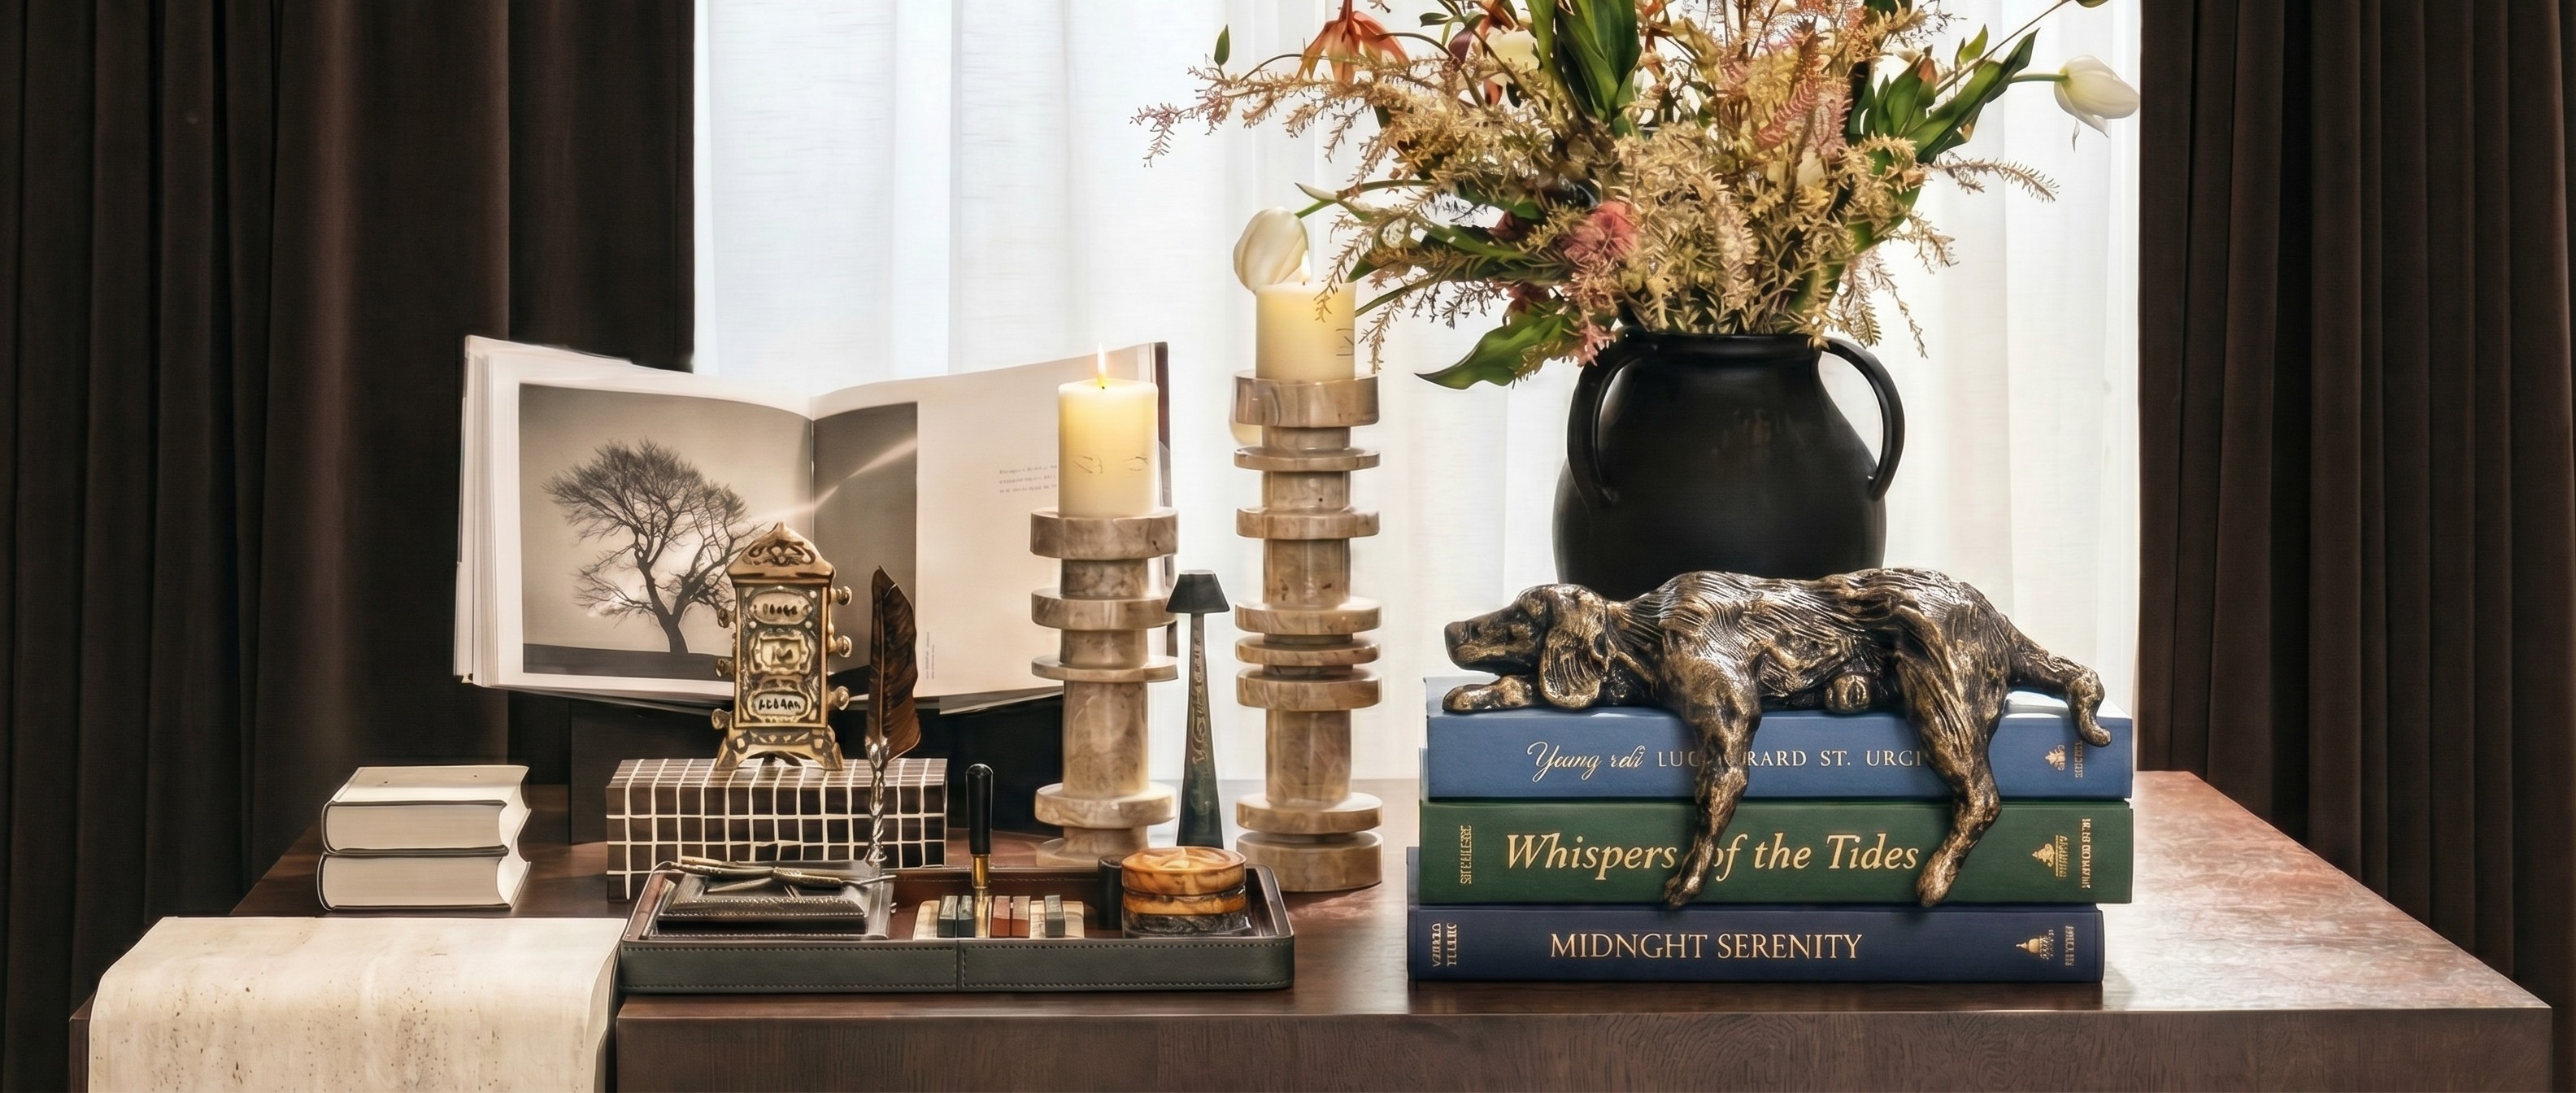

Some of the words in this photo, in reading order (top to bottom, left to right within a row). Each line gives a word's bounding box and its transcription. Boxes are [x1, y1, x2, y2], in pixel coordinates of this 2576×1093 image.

[1820, 749, 1851, 766] ST.
[1507, 832, 1677, 881] Whispers
[1754, 832, 1812, 869] the
[1826, 832, 1919, 870] Tides
[1550, 933, 1708, 959] MIDNGHT
[1717, 933, 1863, 959] SERENITY
